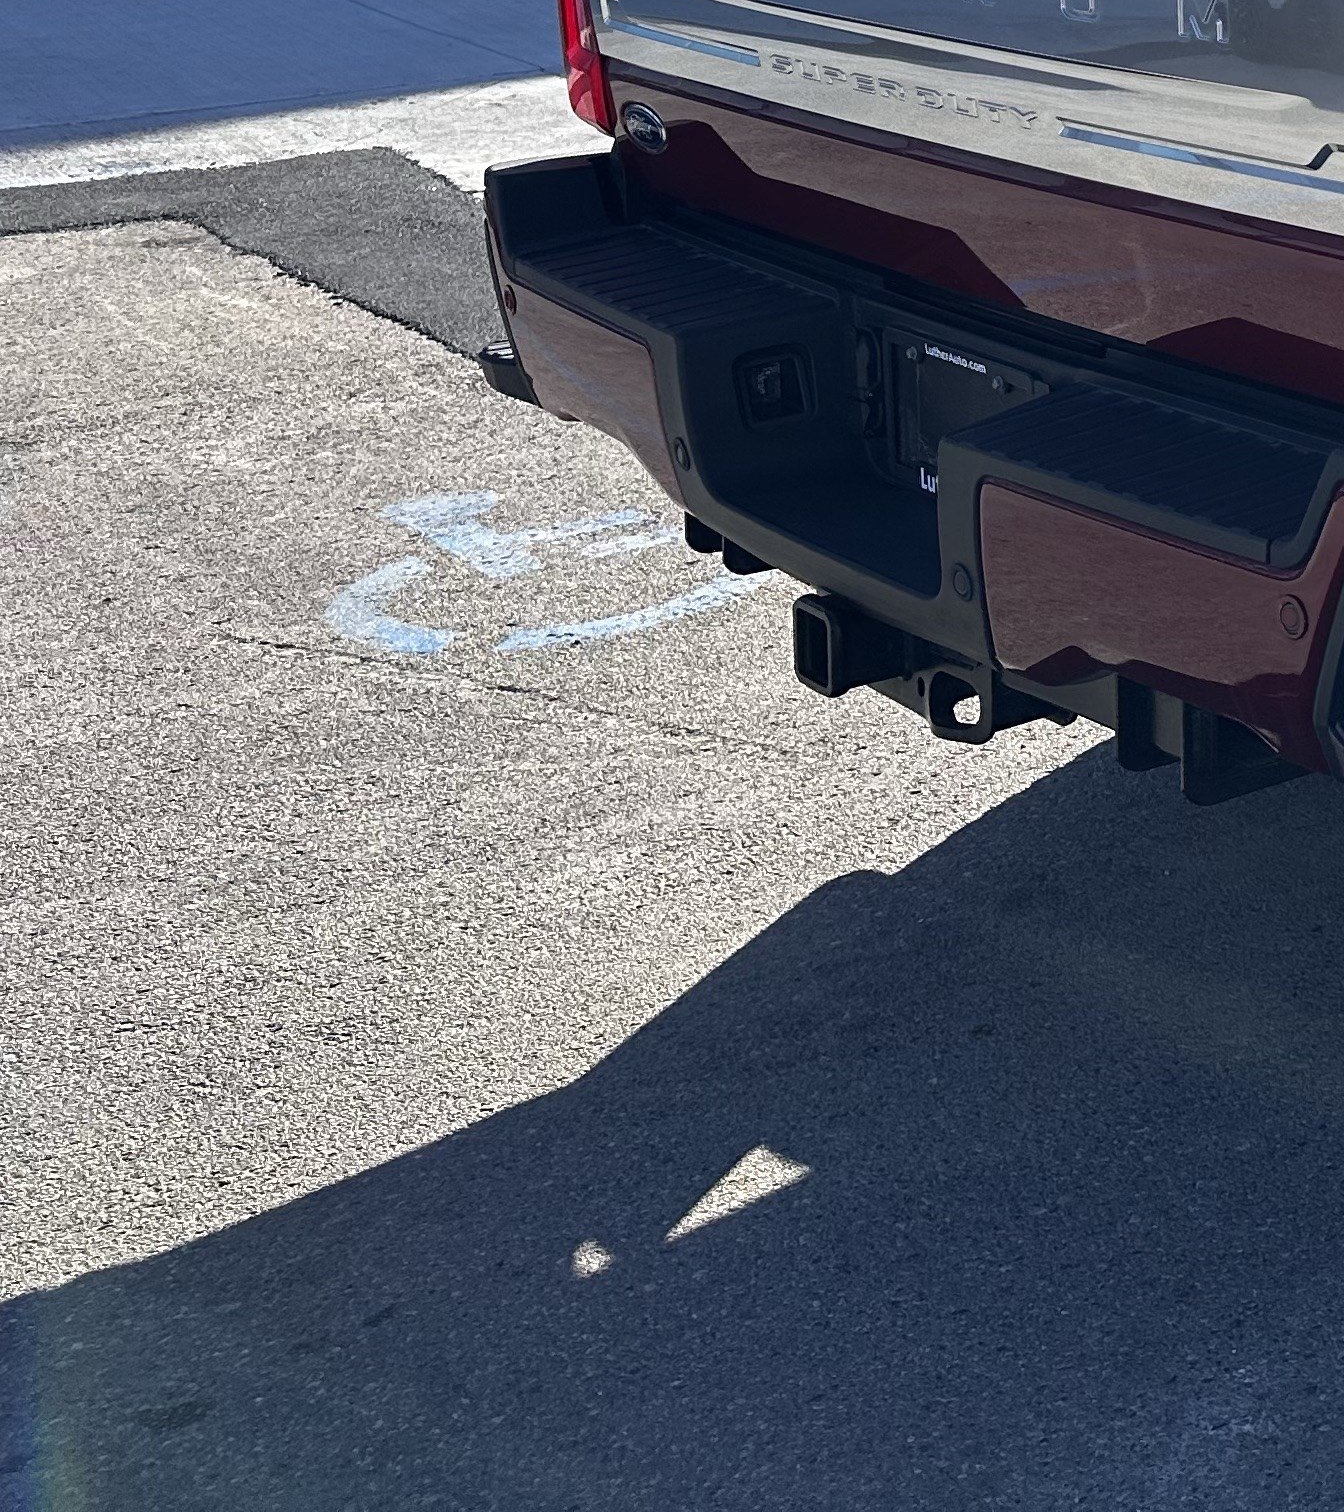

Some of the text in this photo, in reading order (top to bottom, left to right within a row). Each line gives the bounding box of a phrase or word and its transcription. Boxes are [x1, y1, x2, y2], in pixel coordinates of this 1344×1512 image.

[768, 53, 1039, 130] SUPER DUTY
[924, 342, 987, 375] LutherAuto.com
